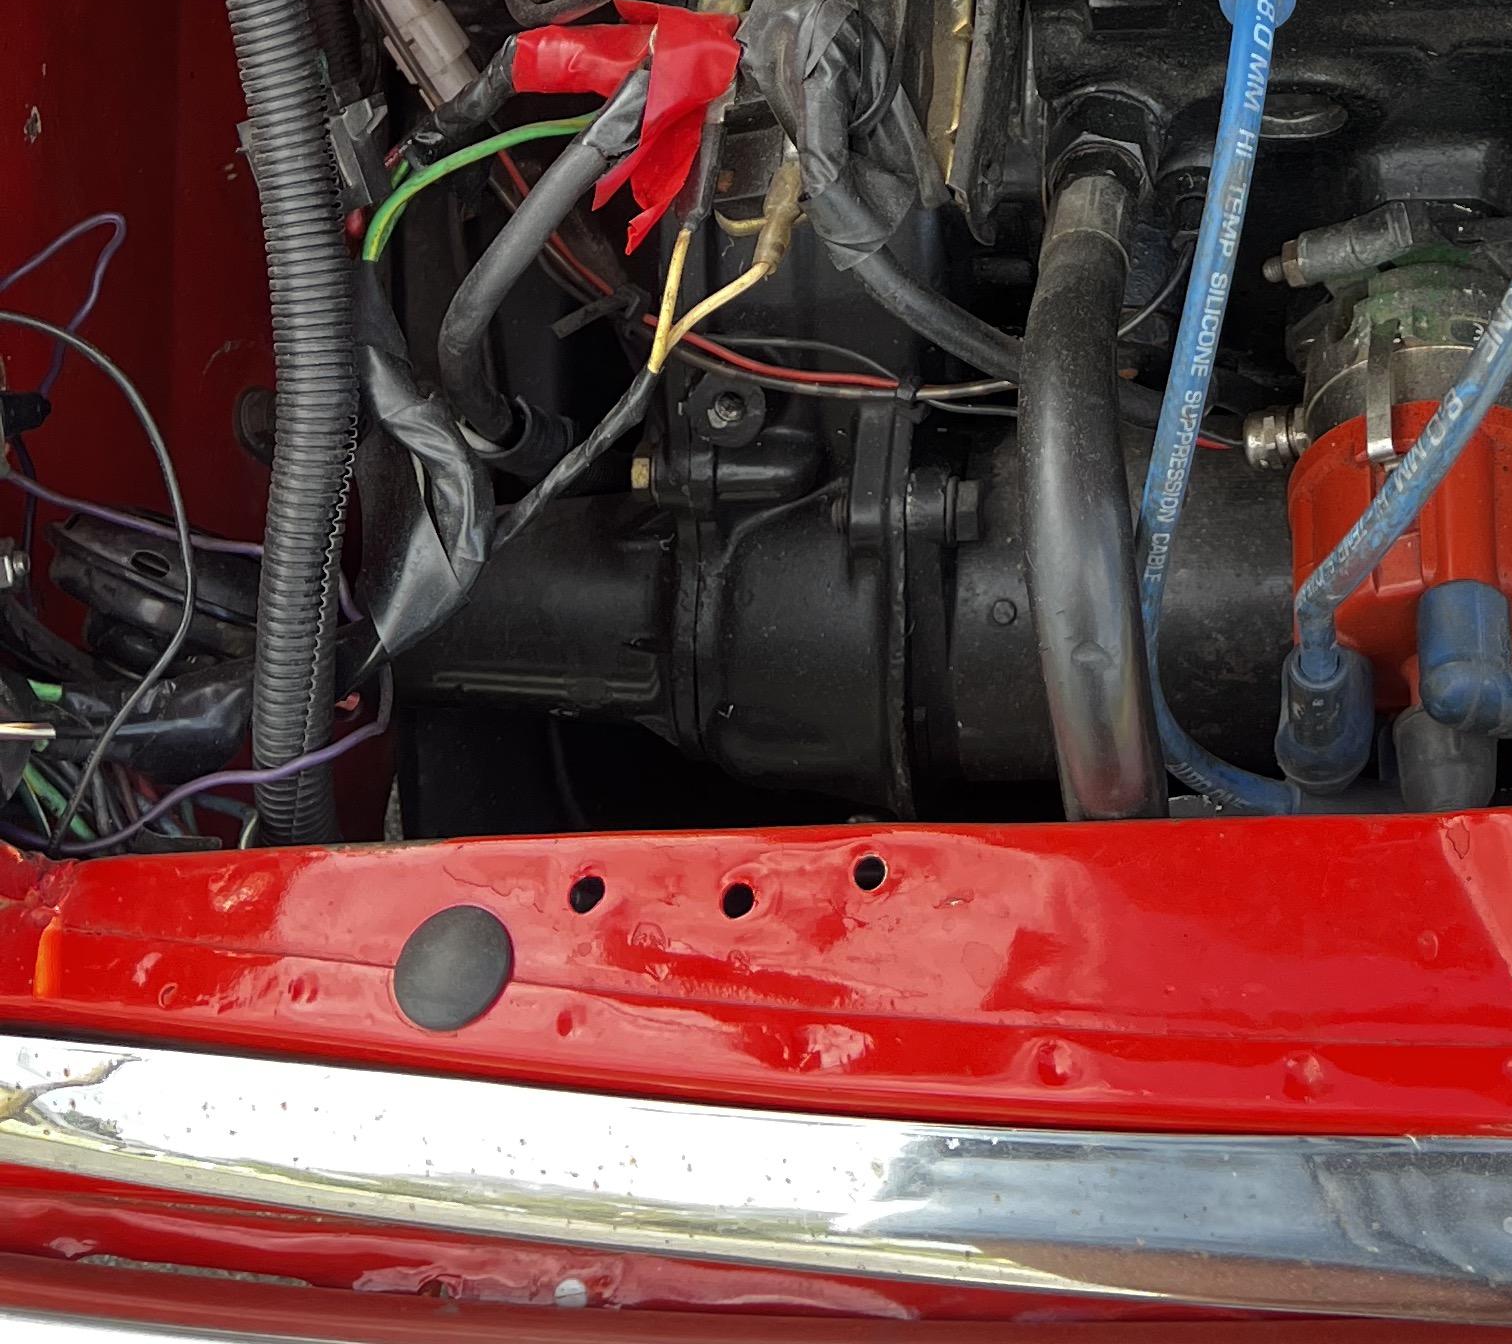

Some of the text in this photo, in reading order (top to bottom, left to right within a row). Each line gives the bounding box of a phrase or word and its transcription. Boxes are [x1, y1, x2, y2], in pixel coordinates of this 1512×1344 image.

[1244, 51, 1271, 112] MM
[1191, 271, 1229, 378] SILICONE
[1156, 389, 1202, 524] SUPPRESSION
[1143, 532, 1171, 585] CABLE
